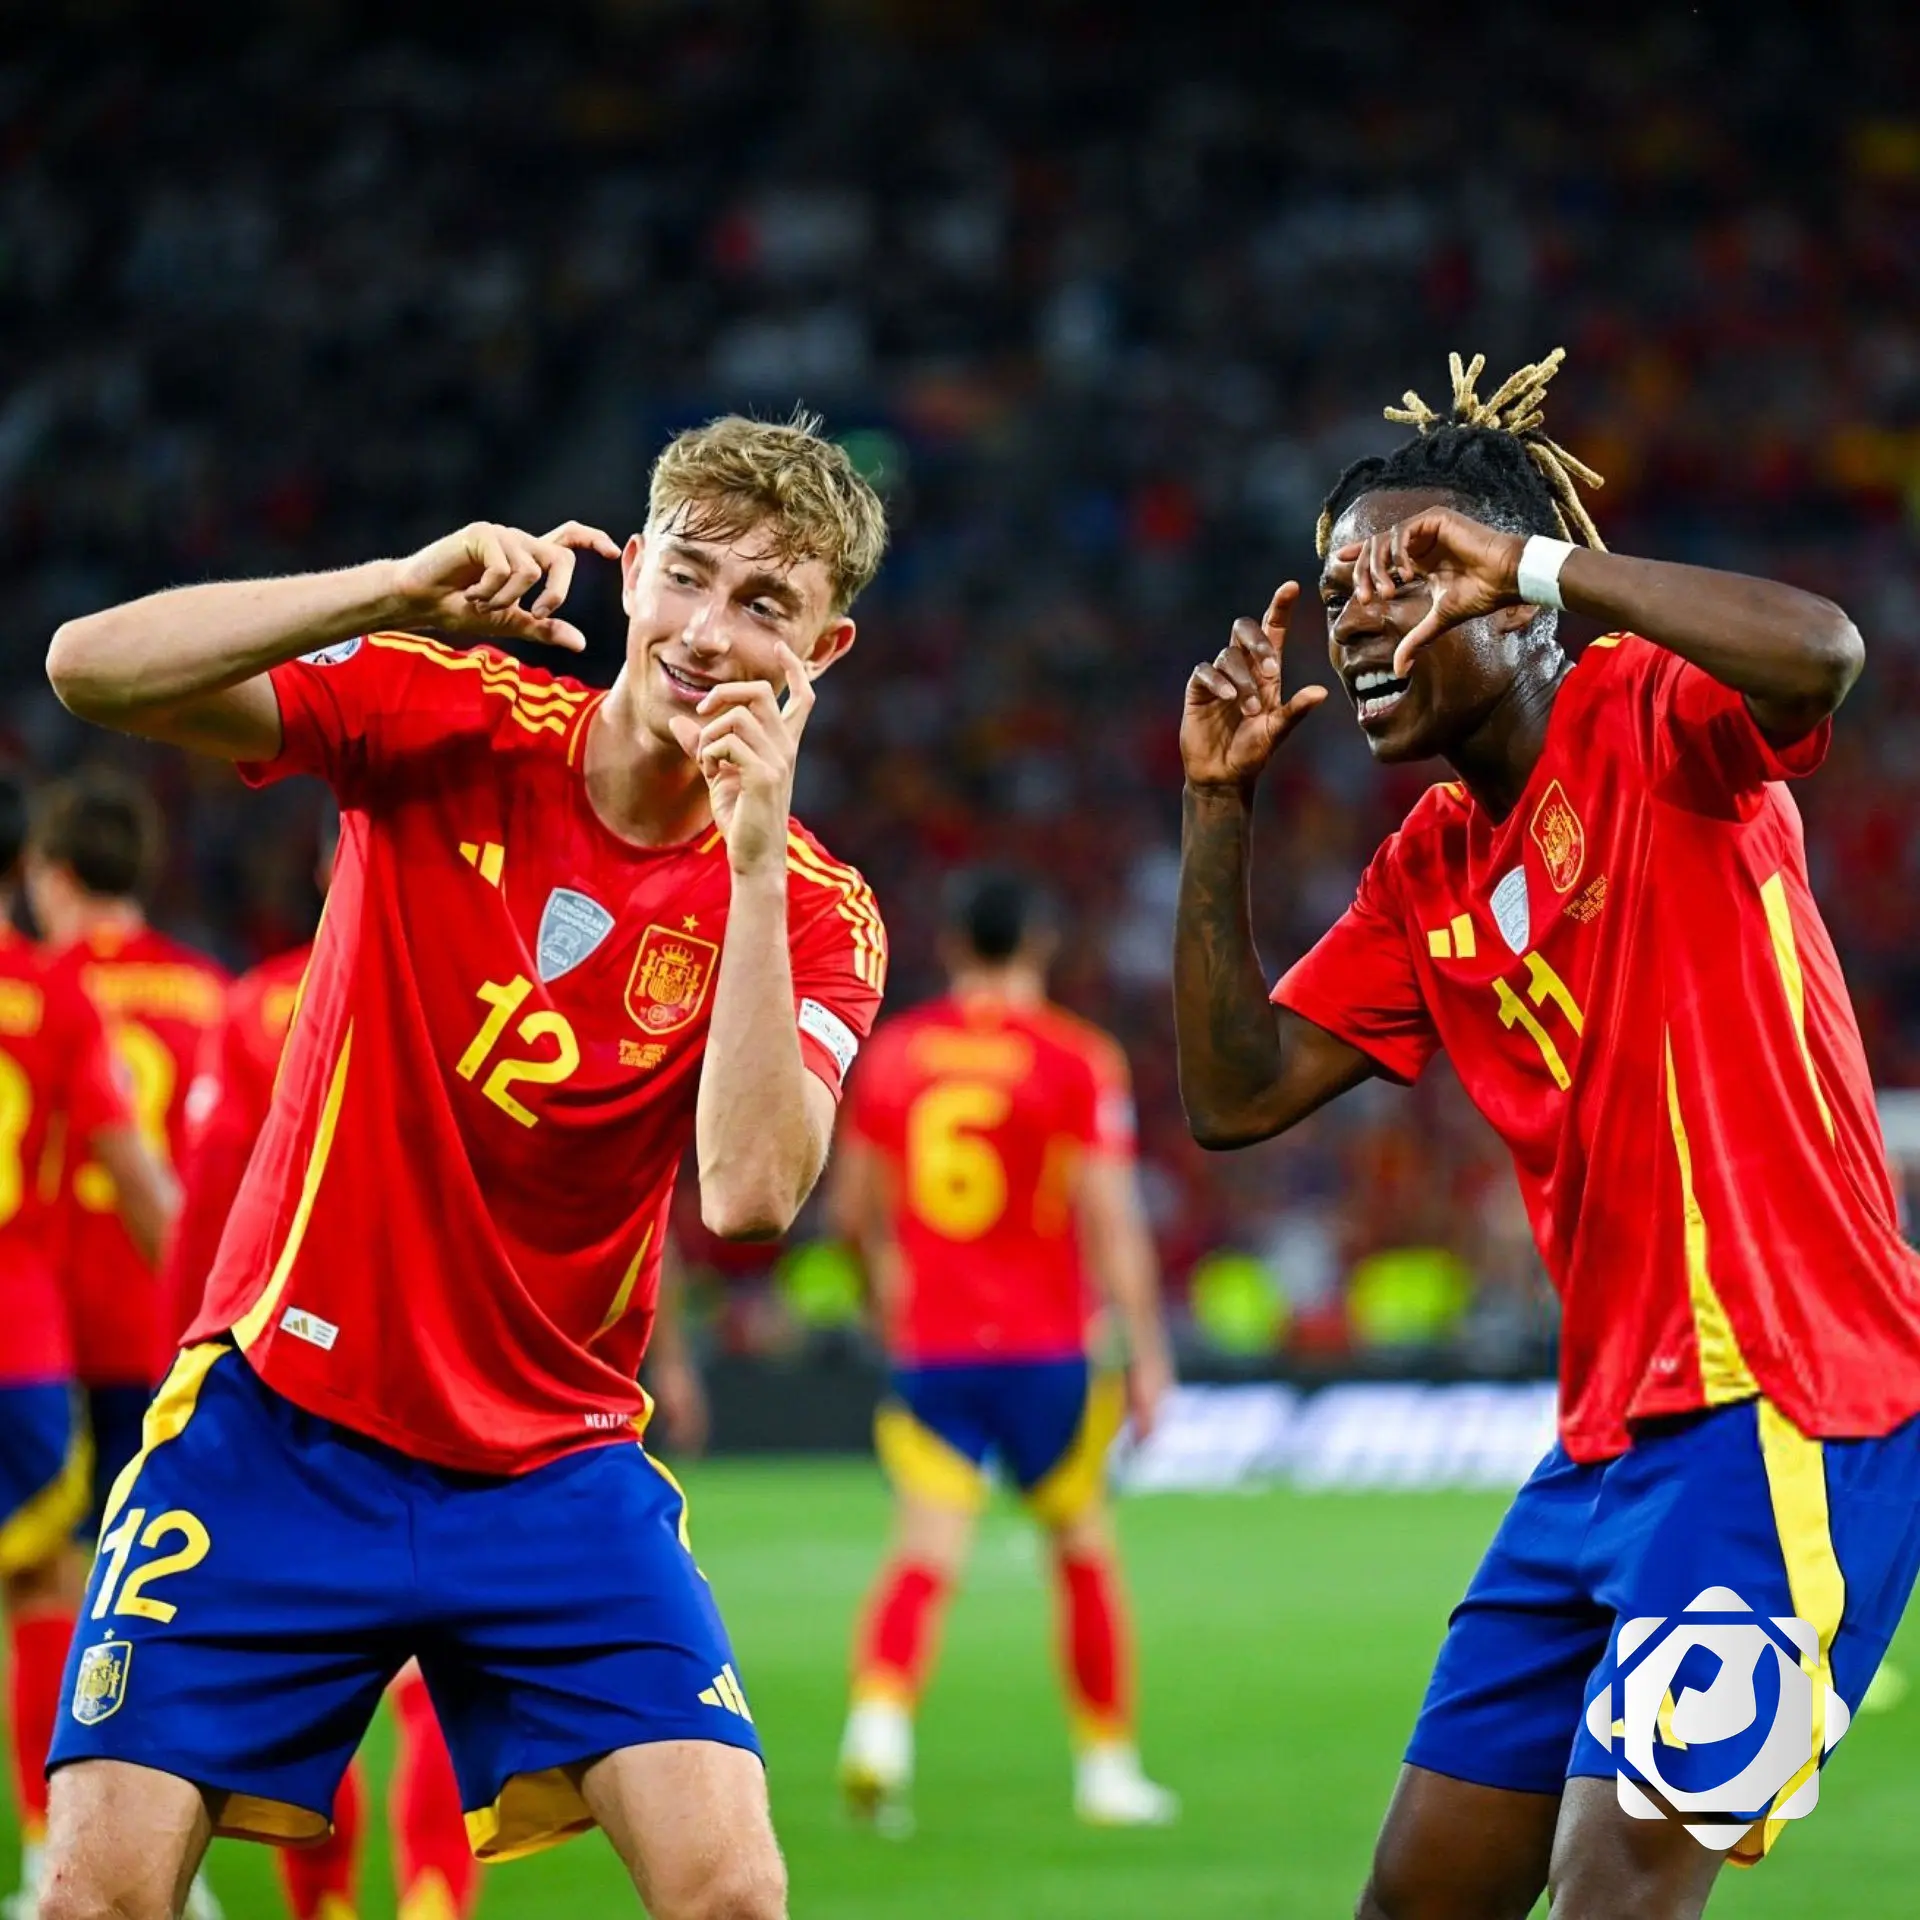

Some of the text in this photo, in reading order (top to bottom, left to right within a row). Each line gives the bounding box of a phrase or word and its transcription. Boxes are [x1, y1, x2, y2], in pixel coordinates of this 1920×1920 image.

[456, 974, 580, 1128] 12
[1491, 950, 1585, 1091] 11
[907, 1080, 1011, 1241] 6
[91, 1508, 211, 1624] 12
